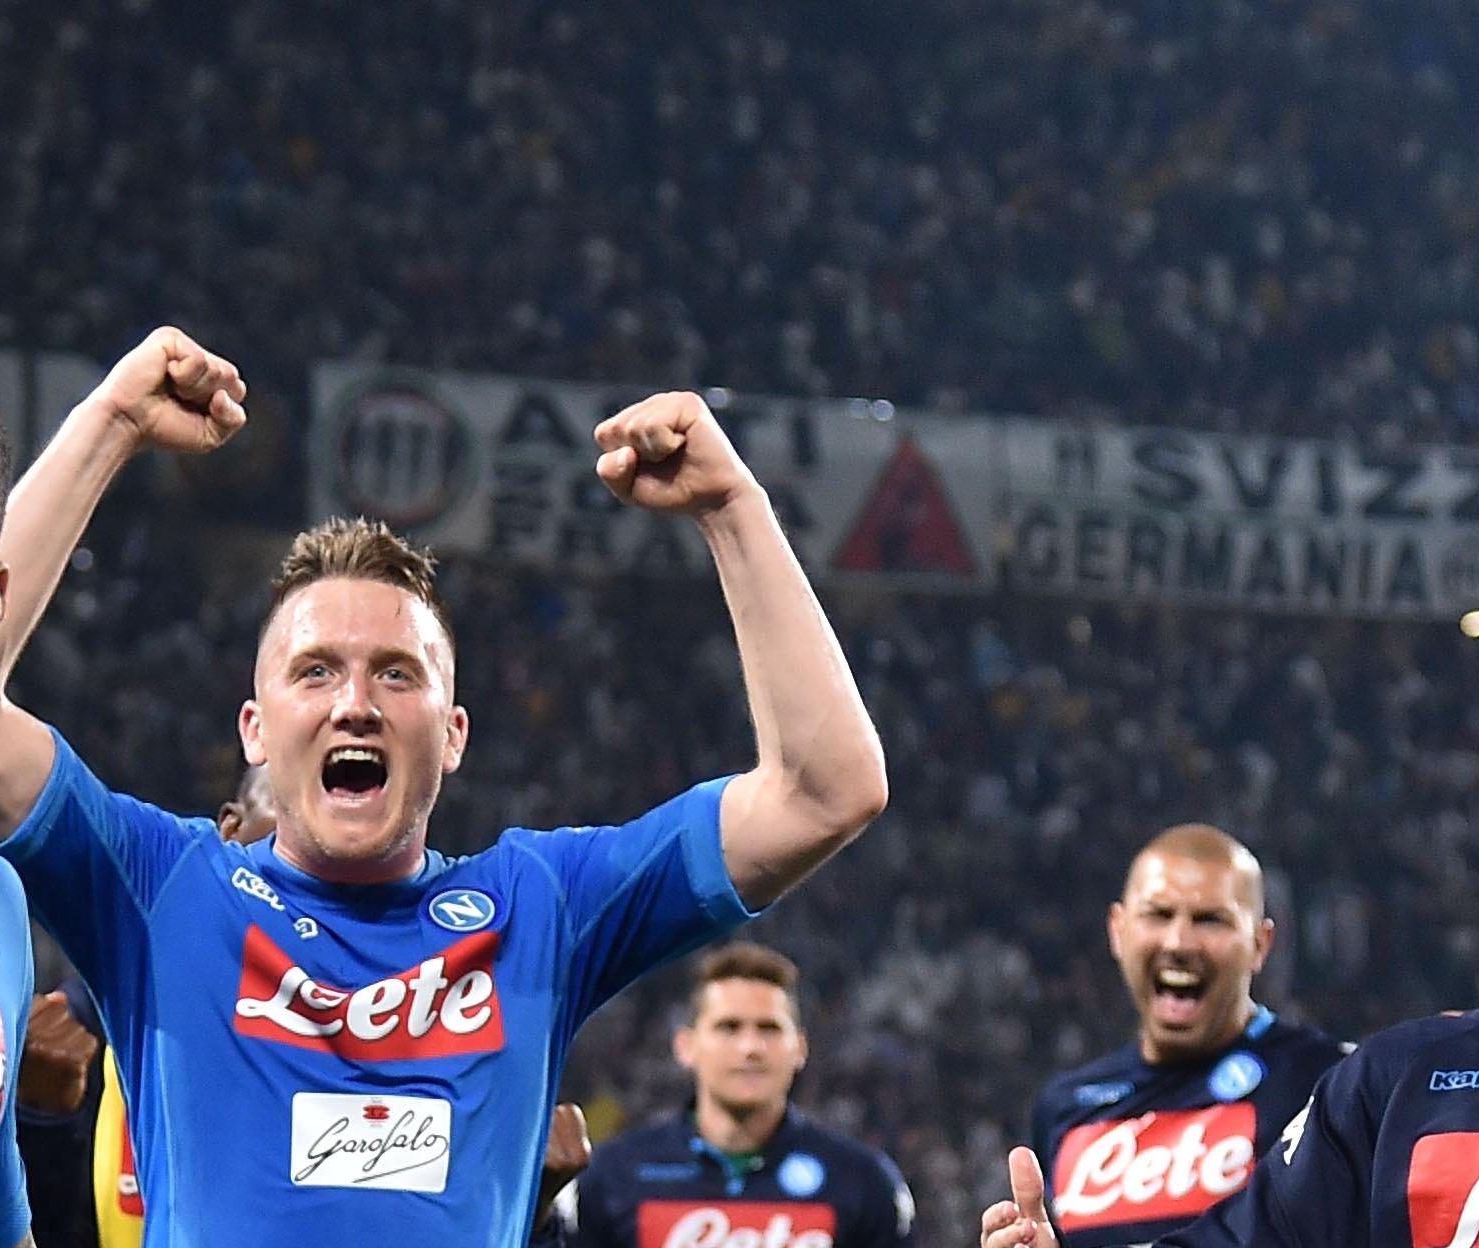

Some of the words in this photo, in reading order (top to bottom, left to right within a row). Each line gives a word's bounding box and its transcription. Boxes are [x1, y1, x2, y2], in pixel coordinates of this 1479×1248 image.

[1017, 502, 1432, 605] GERMANIA
[438, 894, 484, 925] N
[236, 956, 493, 1040] Lete
[294, 1110, 449, 1183] Garofalo
[1054, 1118, 1254, 1217] Lete
